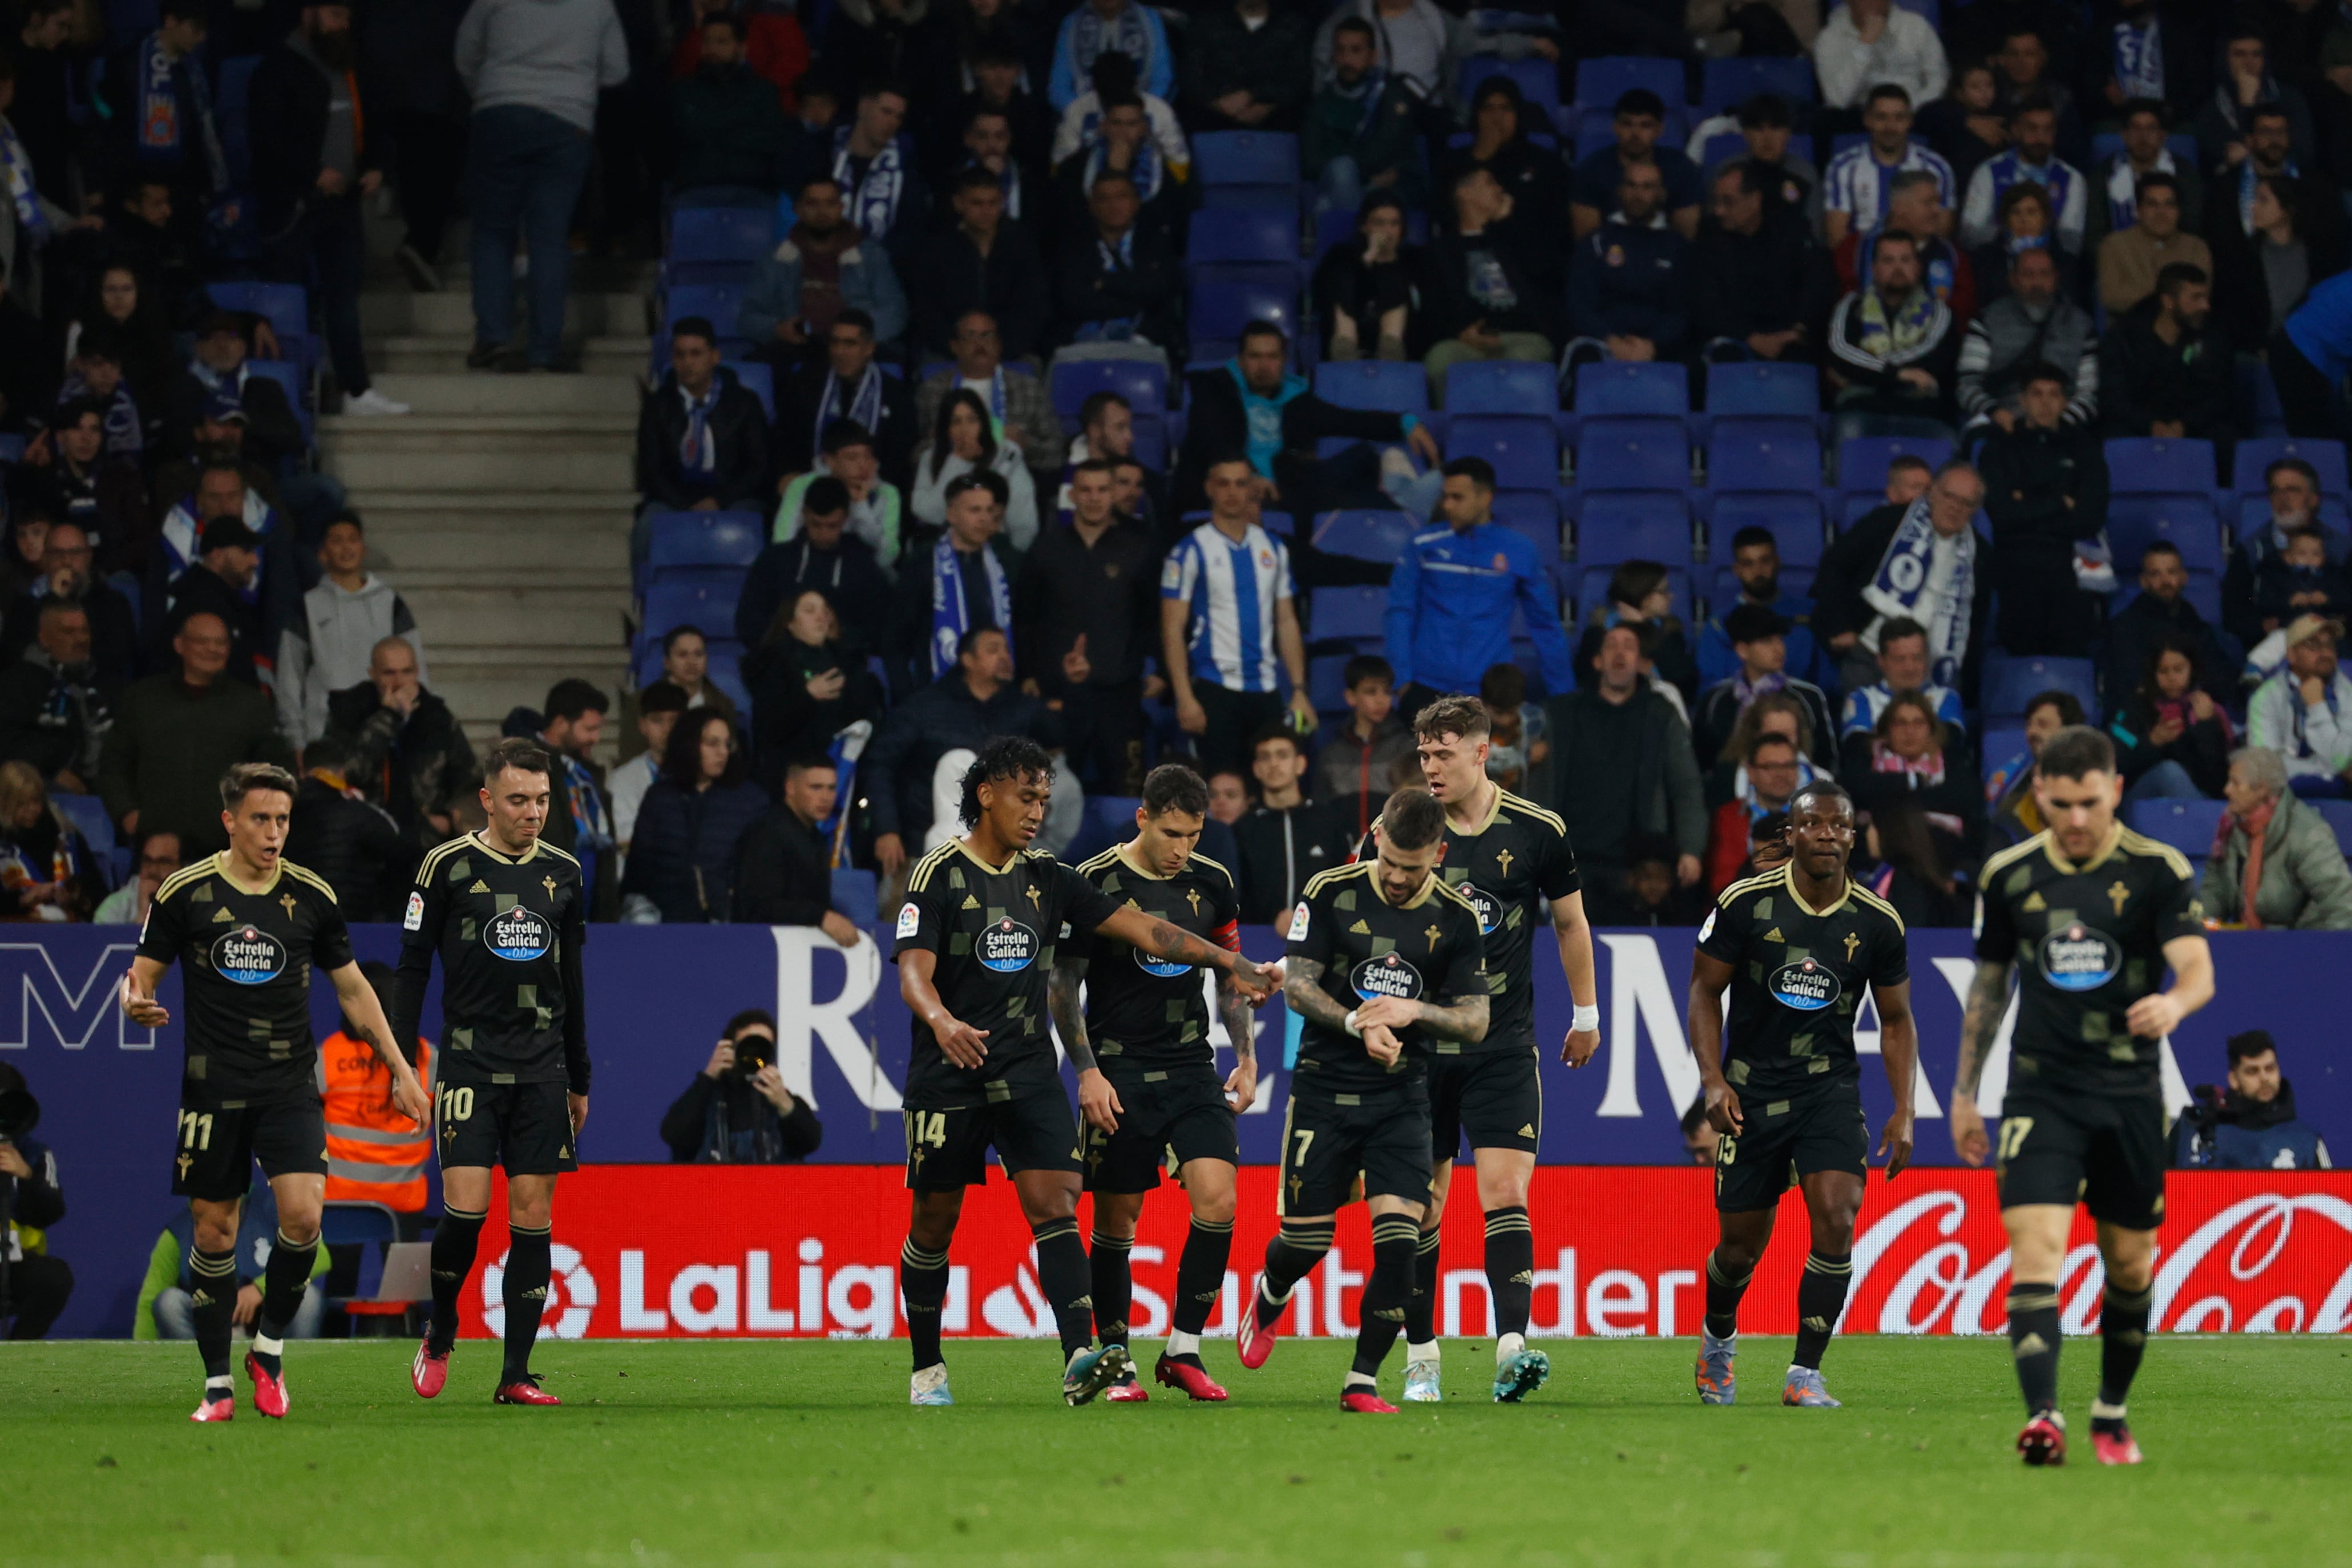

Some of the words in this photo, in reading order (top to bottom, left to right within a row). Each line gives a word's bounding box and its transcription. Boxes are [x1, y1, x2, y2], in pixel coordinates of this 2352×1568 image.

[496, 920, 541, 935] Estrella
[224, 940, 275, 956] Estrella
[498, 934, 539, 947] Galicia
[987, 932, 1029, 945] Estrella
[987, 944, 1027, 959] Galicia
[225, 953, 271, 970] Galicia
[1364, 964, 1413, 985] Estrella
[1781, 970, 1830, 987] Estrella
[1363, 976, 1408, 998] Galicia
[1781, 981, 1825, 999] Galicia
[443, 1087, 475, 1122] 10
[182, 1111, 213, 1151] 11
[915, 1110, 946, 1149] 14
[1997, 1116, 2035, 1160] 17
[1294, 1129, 1315, 1167] 7
[1127, 1246, 1698, 1337] Stnder
